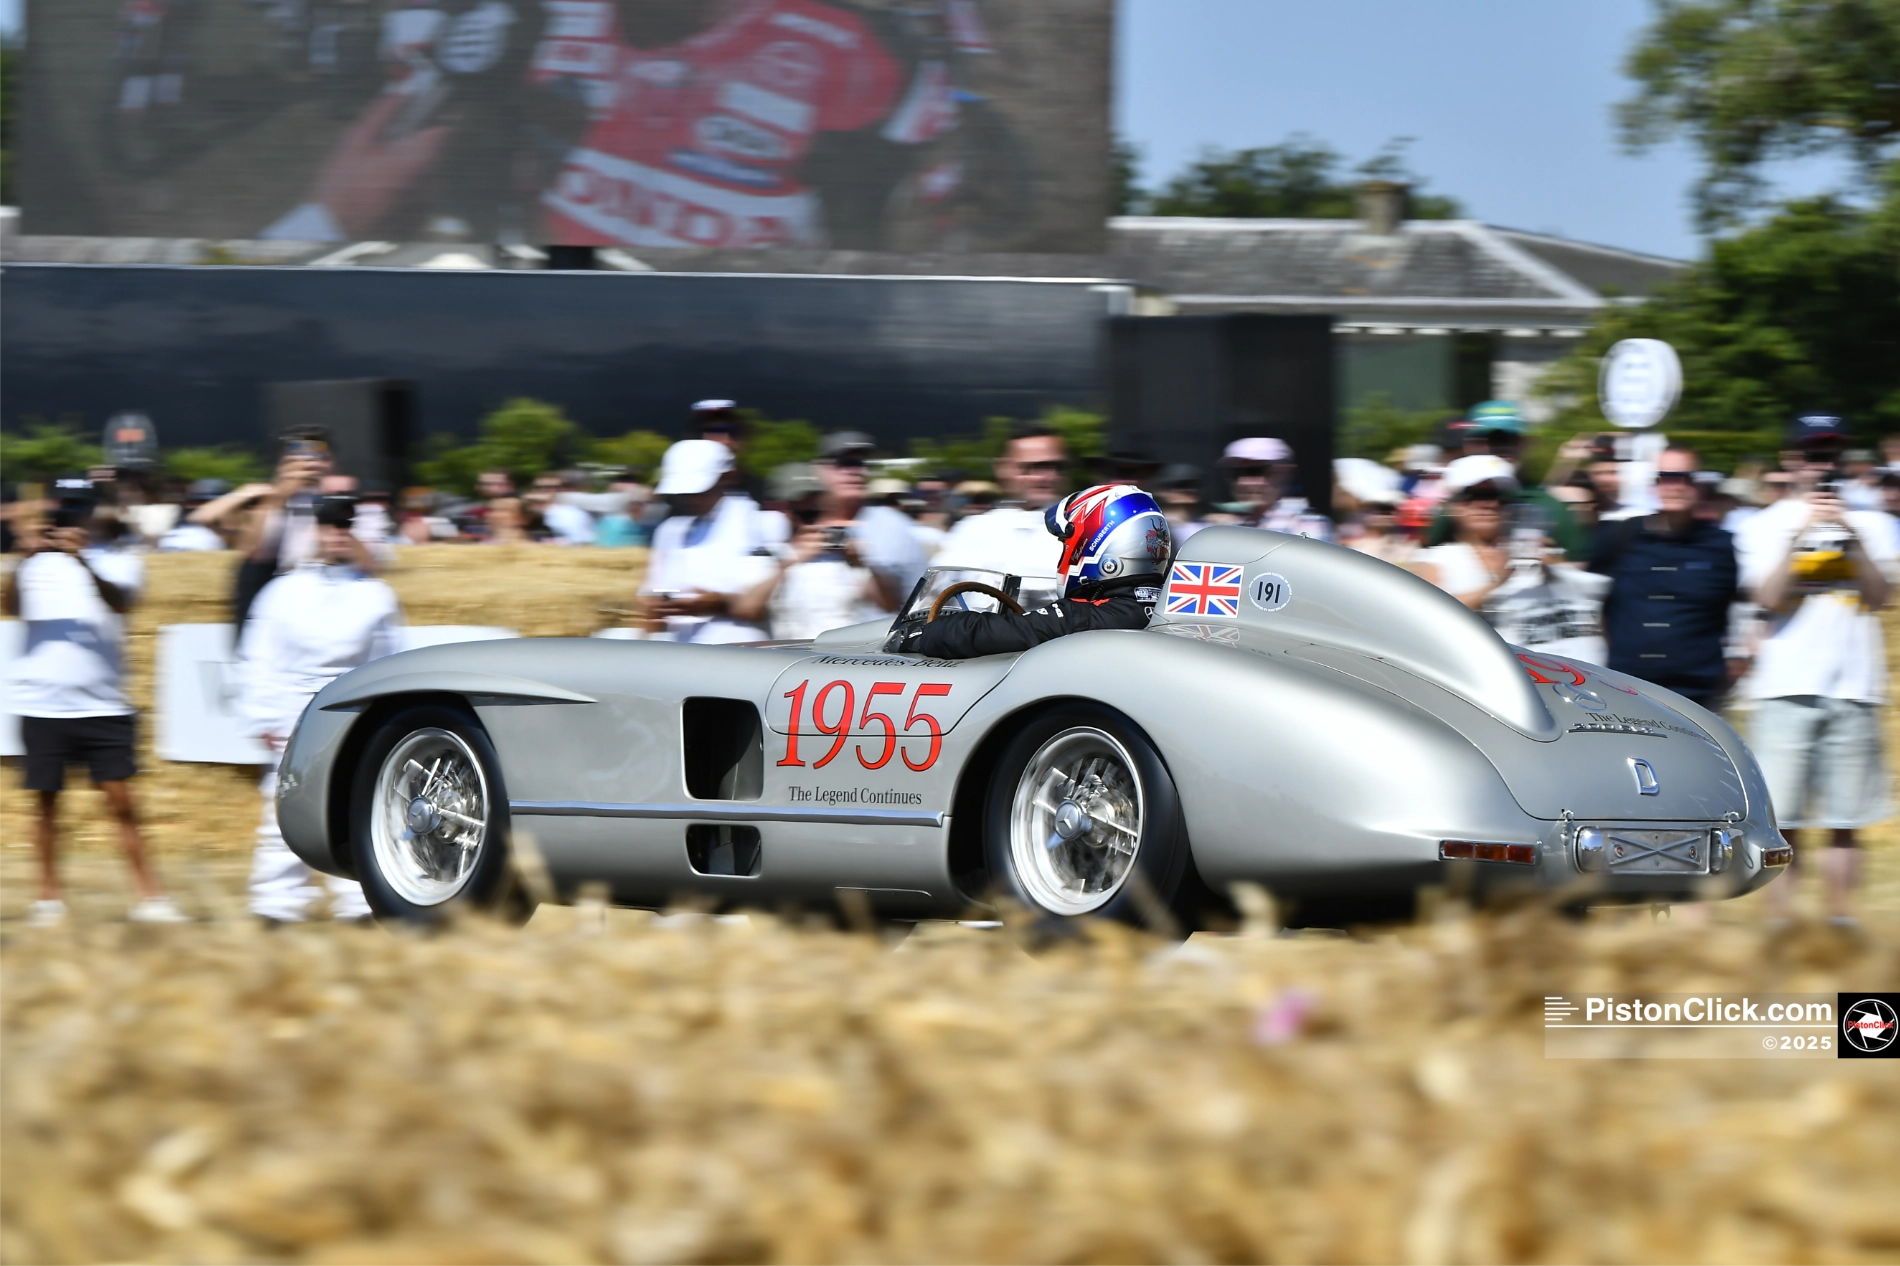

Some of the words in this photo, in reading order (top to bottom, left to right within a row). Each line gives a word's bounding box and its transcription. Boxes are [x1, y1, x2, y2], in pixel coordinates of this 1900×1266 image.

[1088, 520, 1116, 552] SCHUBERTH
[1257, 581, 1281, 604] 191
[811, 655, 966, 669] Mercedes-Benz
[776, 679, 954, 773] 1955
[1586, 712, 1615, 723] The
[1627, 756, 1660, 796] D
[788, 786, 812, 801] The
[814, 786, 858, 806] Legend
[860, 787, 922, 805] Continues
